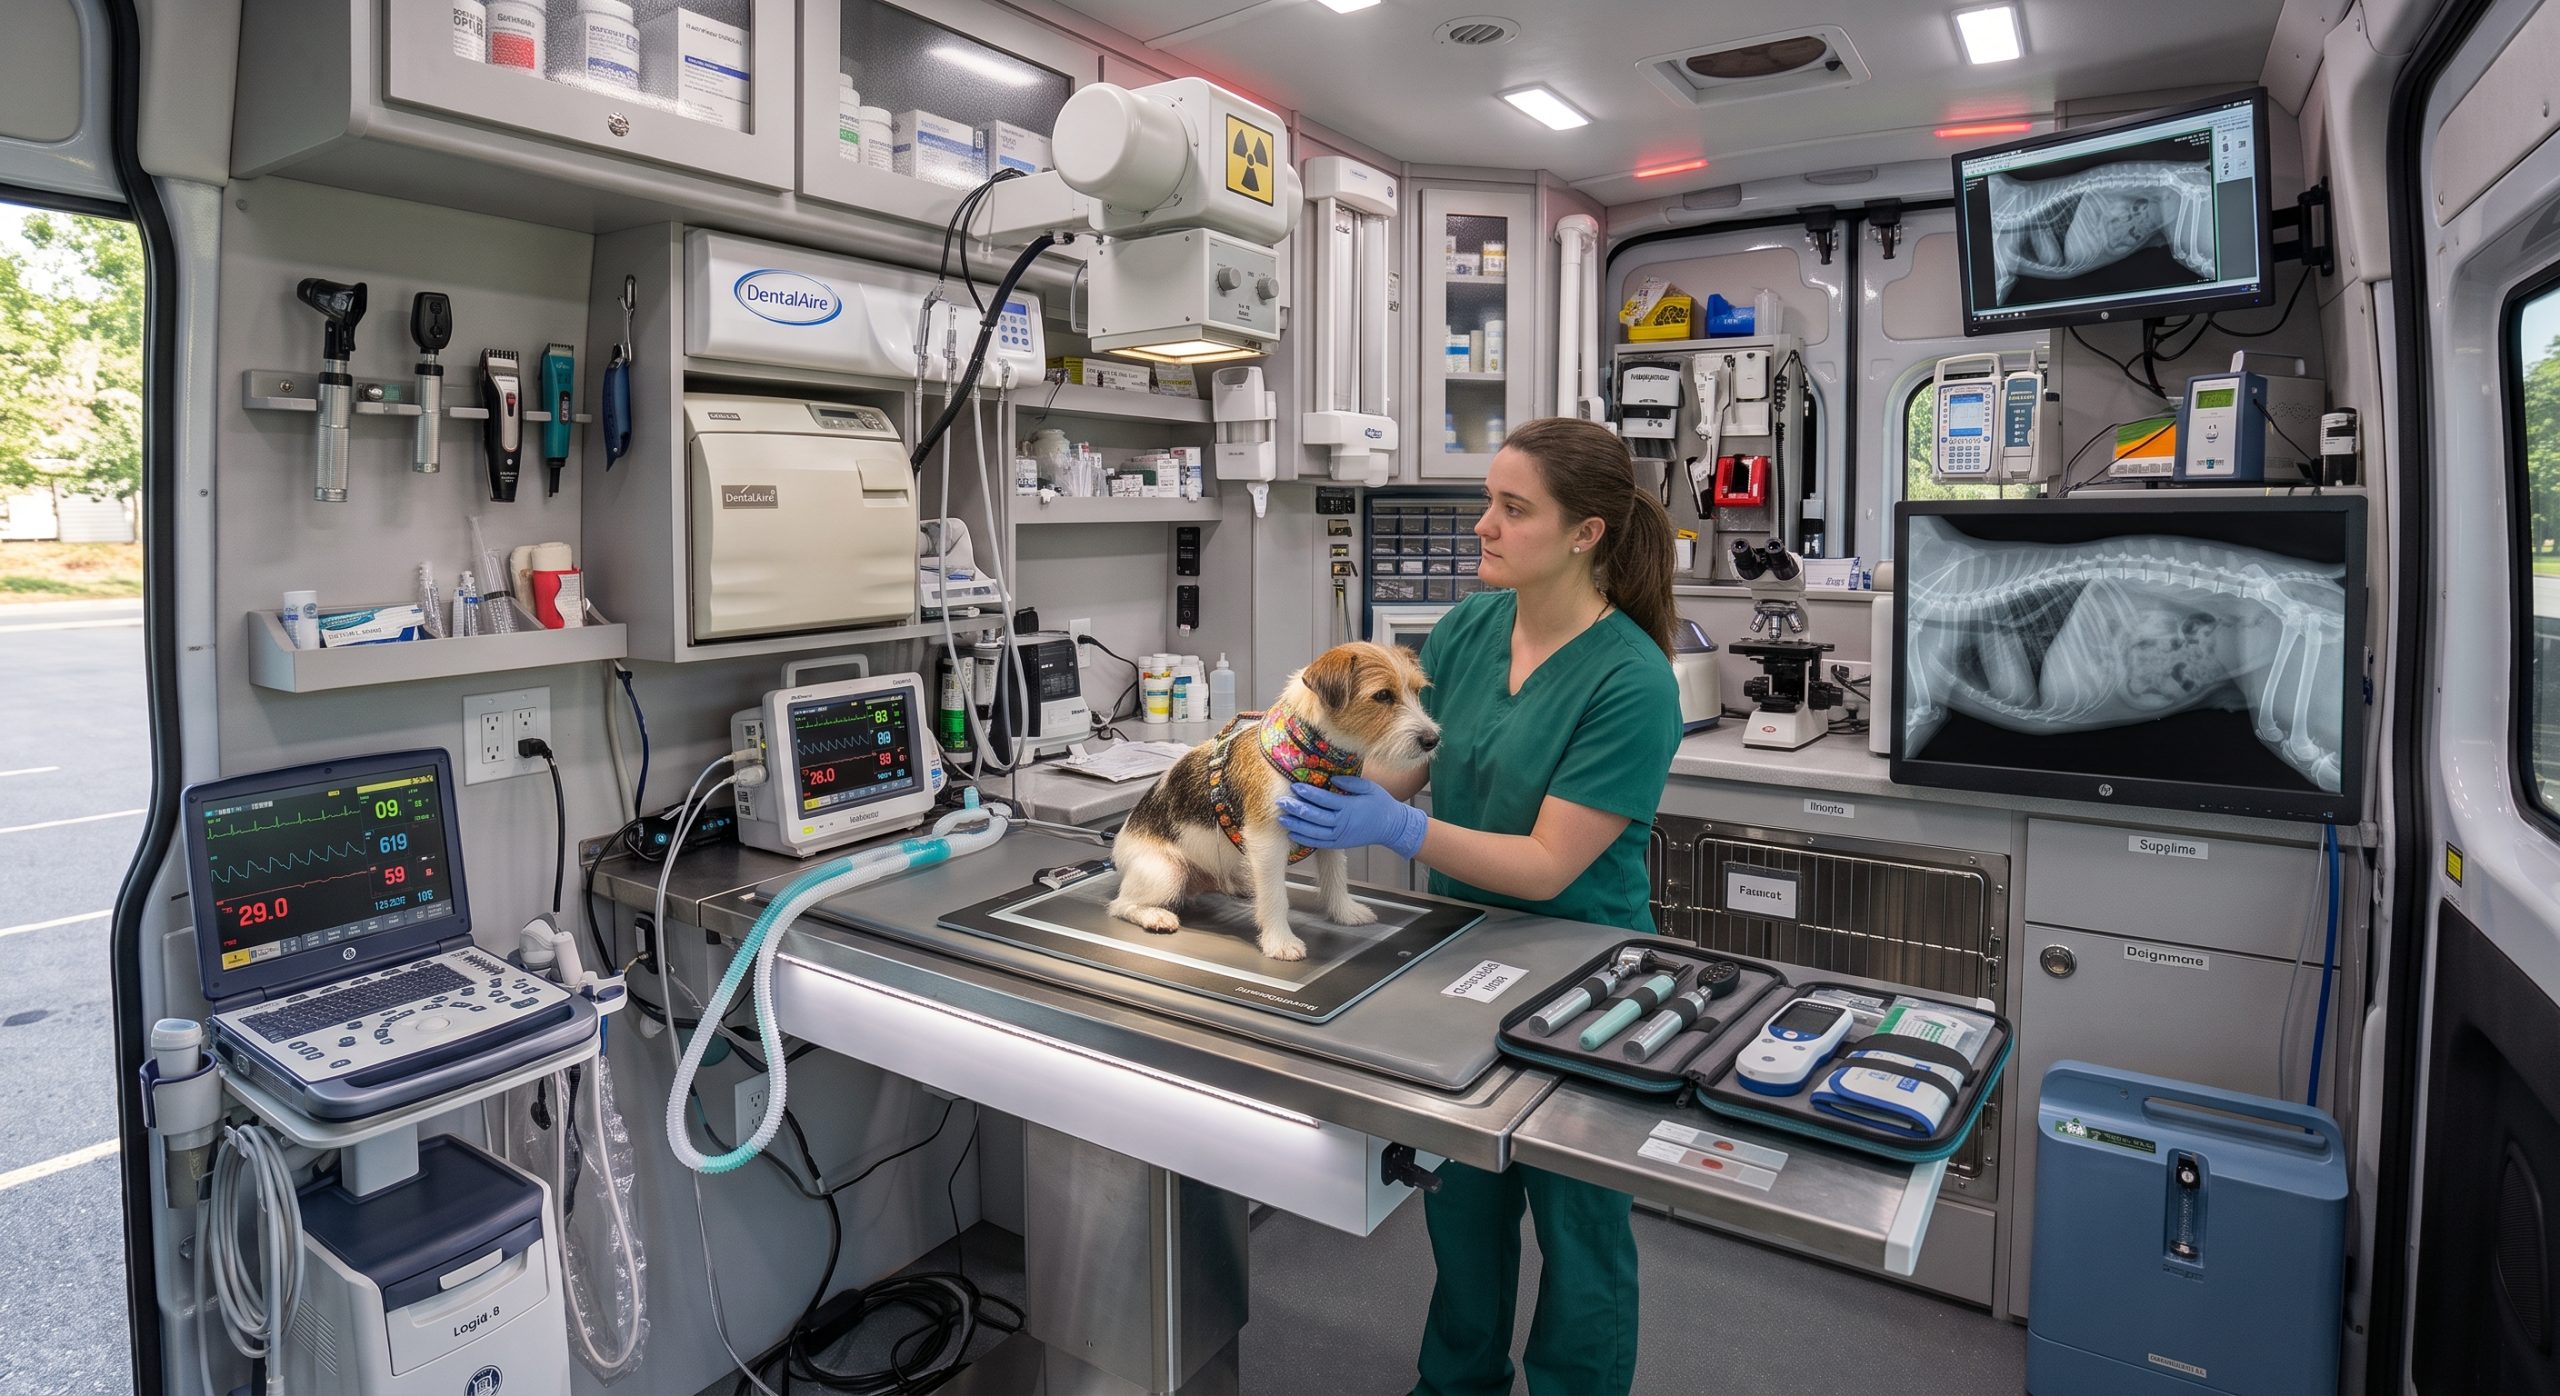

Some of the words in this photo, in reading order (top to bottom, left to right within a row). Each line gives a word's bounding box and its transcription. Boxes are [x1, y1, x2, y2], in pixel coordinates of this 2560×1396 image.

[747, 283, 829, 311] DentalAire
[725, 493, 775, 502] DentalAire
[380, 832, 408, 854] 619
[384, 865, 406, 885] 59
[238, 897, 289, 927] 29.0
